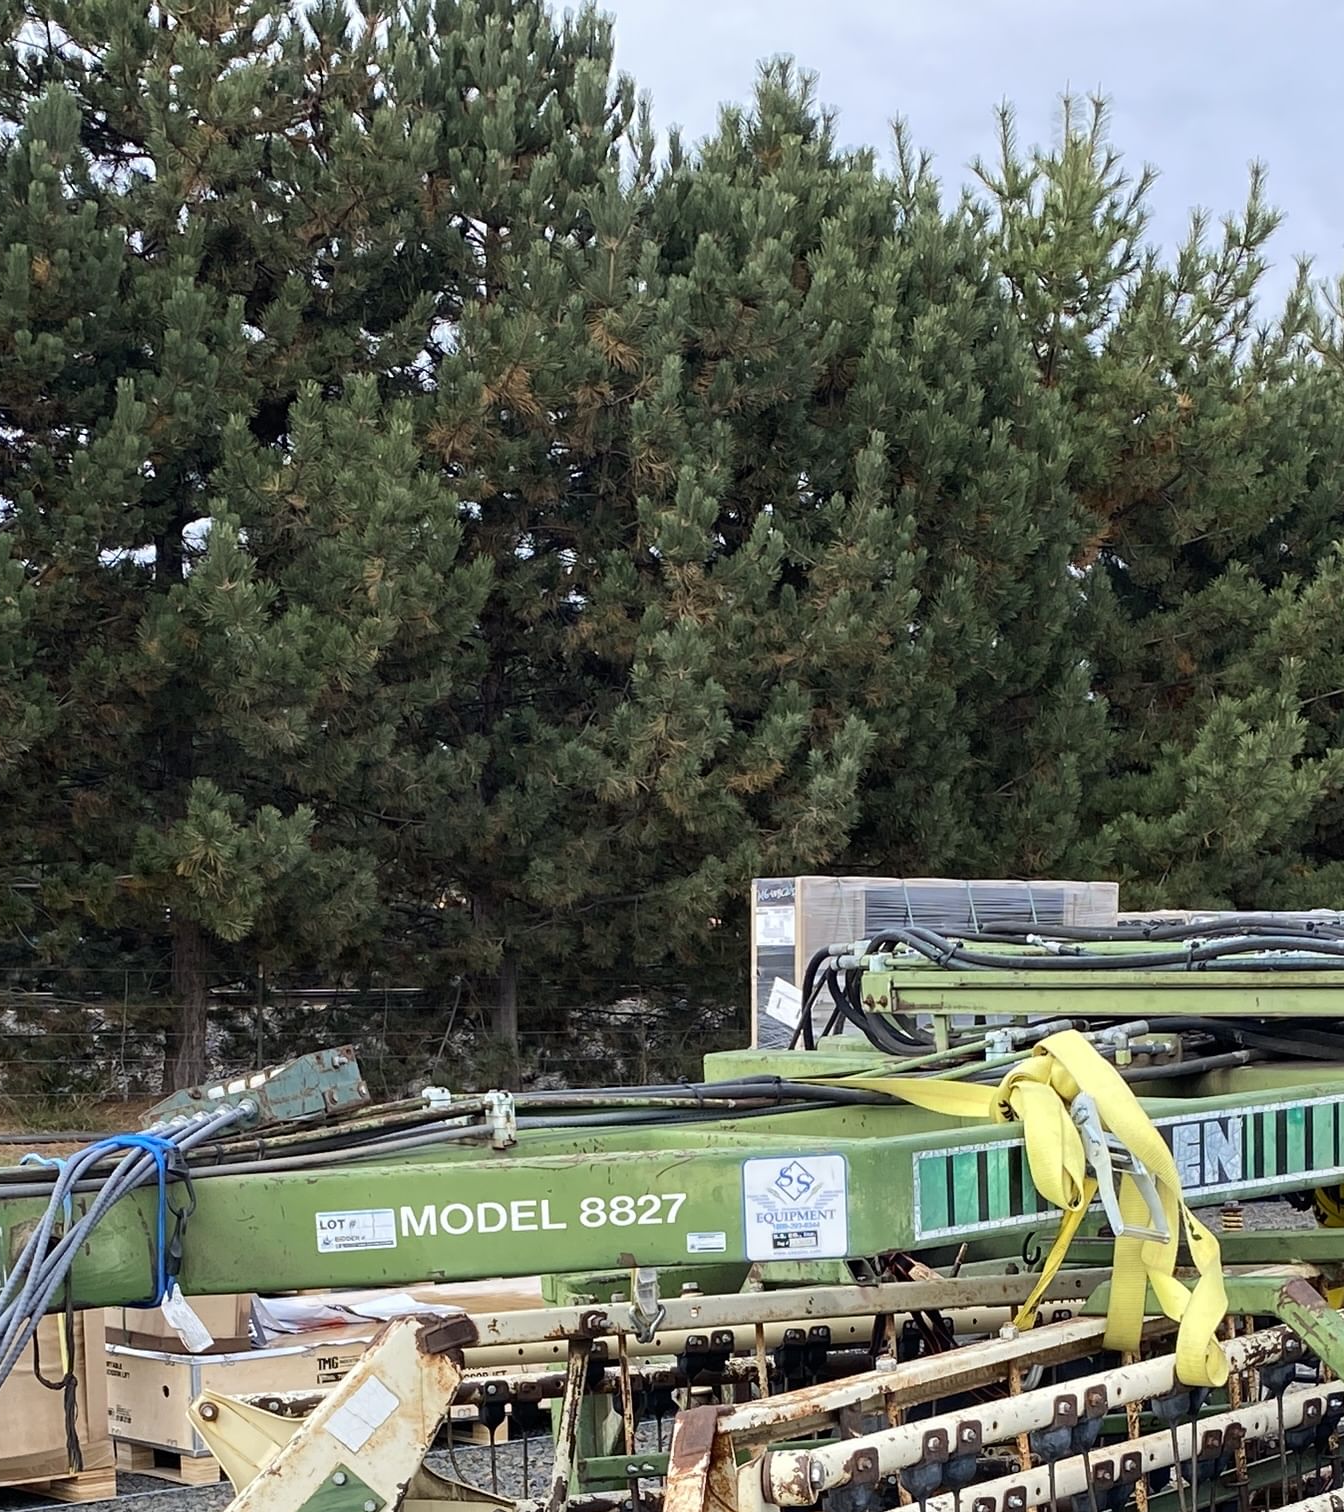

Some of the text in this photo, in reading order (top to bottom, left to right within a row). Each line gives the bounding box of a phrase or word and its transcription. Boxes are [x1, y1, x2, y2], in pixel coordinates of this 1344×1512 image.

[1172, 1117, 1243, 1187] EN
[400, 1193, 687, 1237] MODEL 8827
[756, 1209, 836, 1224] EQUIPMENT
[319, 1219, 345, 1230] LOT
[317, 1356, 339, 1370] TMG
